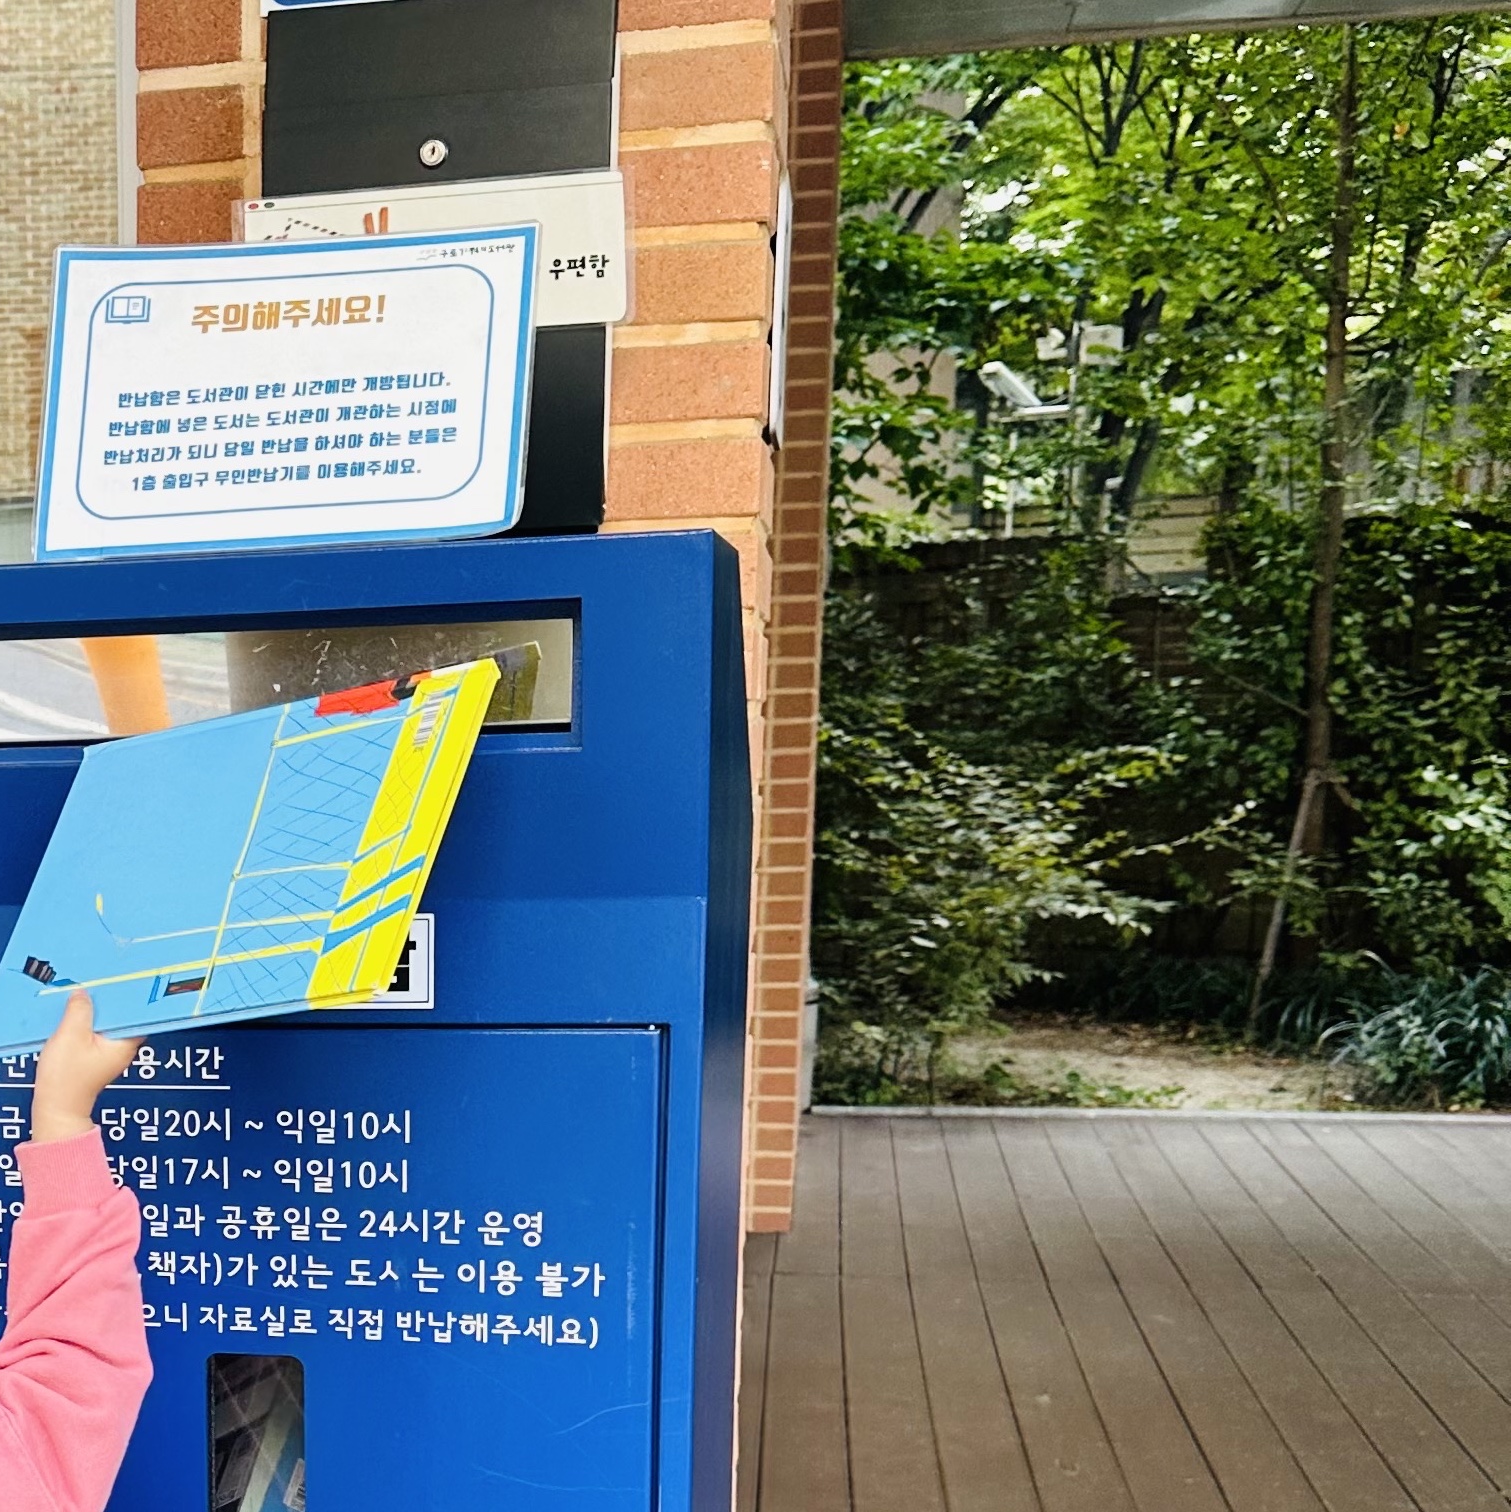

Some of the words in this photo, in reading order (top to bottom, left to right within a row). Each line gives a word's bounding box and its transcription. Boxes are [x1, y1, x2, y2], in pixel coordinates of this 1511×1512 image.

[549, 254, 610, 280] 우편함
[191, 294, 386, 334] 주의해주세요!
[118, 390, 181, 408] 반납함은
[186, 385, 249, 405] 도서관이
[255, 382, 286, 400] 닫힌
[292, 378, 357, 397] 시간에만
[362, 371, 451, 392] 개방됩니다.
[108, 418, 171, 437] 반납함에
[177, 416, 208, 433] 넣은
[213, 413, 260, 430] 도서는
[265, 407, 329, 427] 도서관이
[336, 403, 401, 421] 개관하는
[407, 398, 457, 417] 시점에
[103, 446, 182, 466] 반납처리가
[187, 443, 218, 460] 되니
[224, 440, 255, 457] 당일
[261, 437, 309, 455] 반납을
[314, 433, 364, 451] 하셔야
[369, 431, 401, 448] 하는
[408, 427, 457, 445] 분들은
[132, 475, 156, 491] 1층
[162, 472, 209, 490] 출입구
[215, 464, 311, 486] 무인반납기를
[317, 458, 422, 479] 이용해주세요.
[123, 1045, 225, 1080] 용시간
[101, 1107, 231, 1142] 당일20시
[276, 1108, 411, 1145] 익일10시
[107, 1155, 229, 1190] 당일17시
[274, 1157, 408, 1194] 익일10시
[216, 1204, 347, 1242] 공휴일은
[359, 1208, 466, 1245] 24시간
[477, 1211, 544, 1248] 운영
[269, 1254, 334, 1290] 있는
[457, 1259, 523, 1296] 이용
[535, 1261, 606, 1298] 불가
[199, 1303, 318, 1338] 자료실로
[328, 1307, 384, 1341] 직접
[396, 1309, 600, 1349] 반납해주세요)
